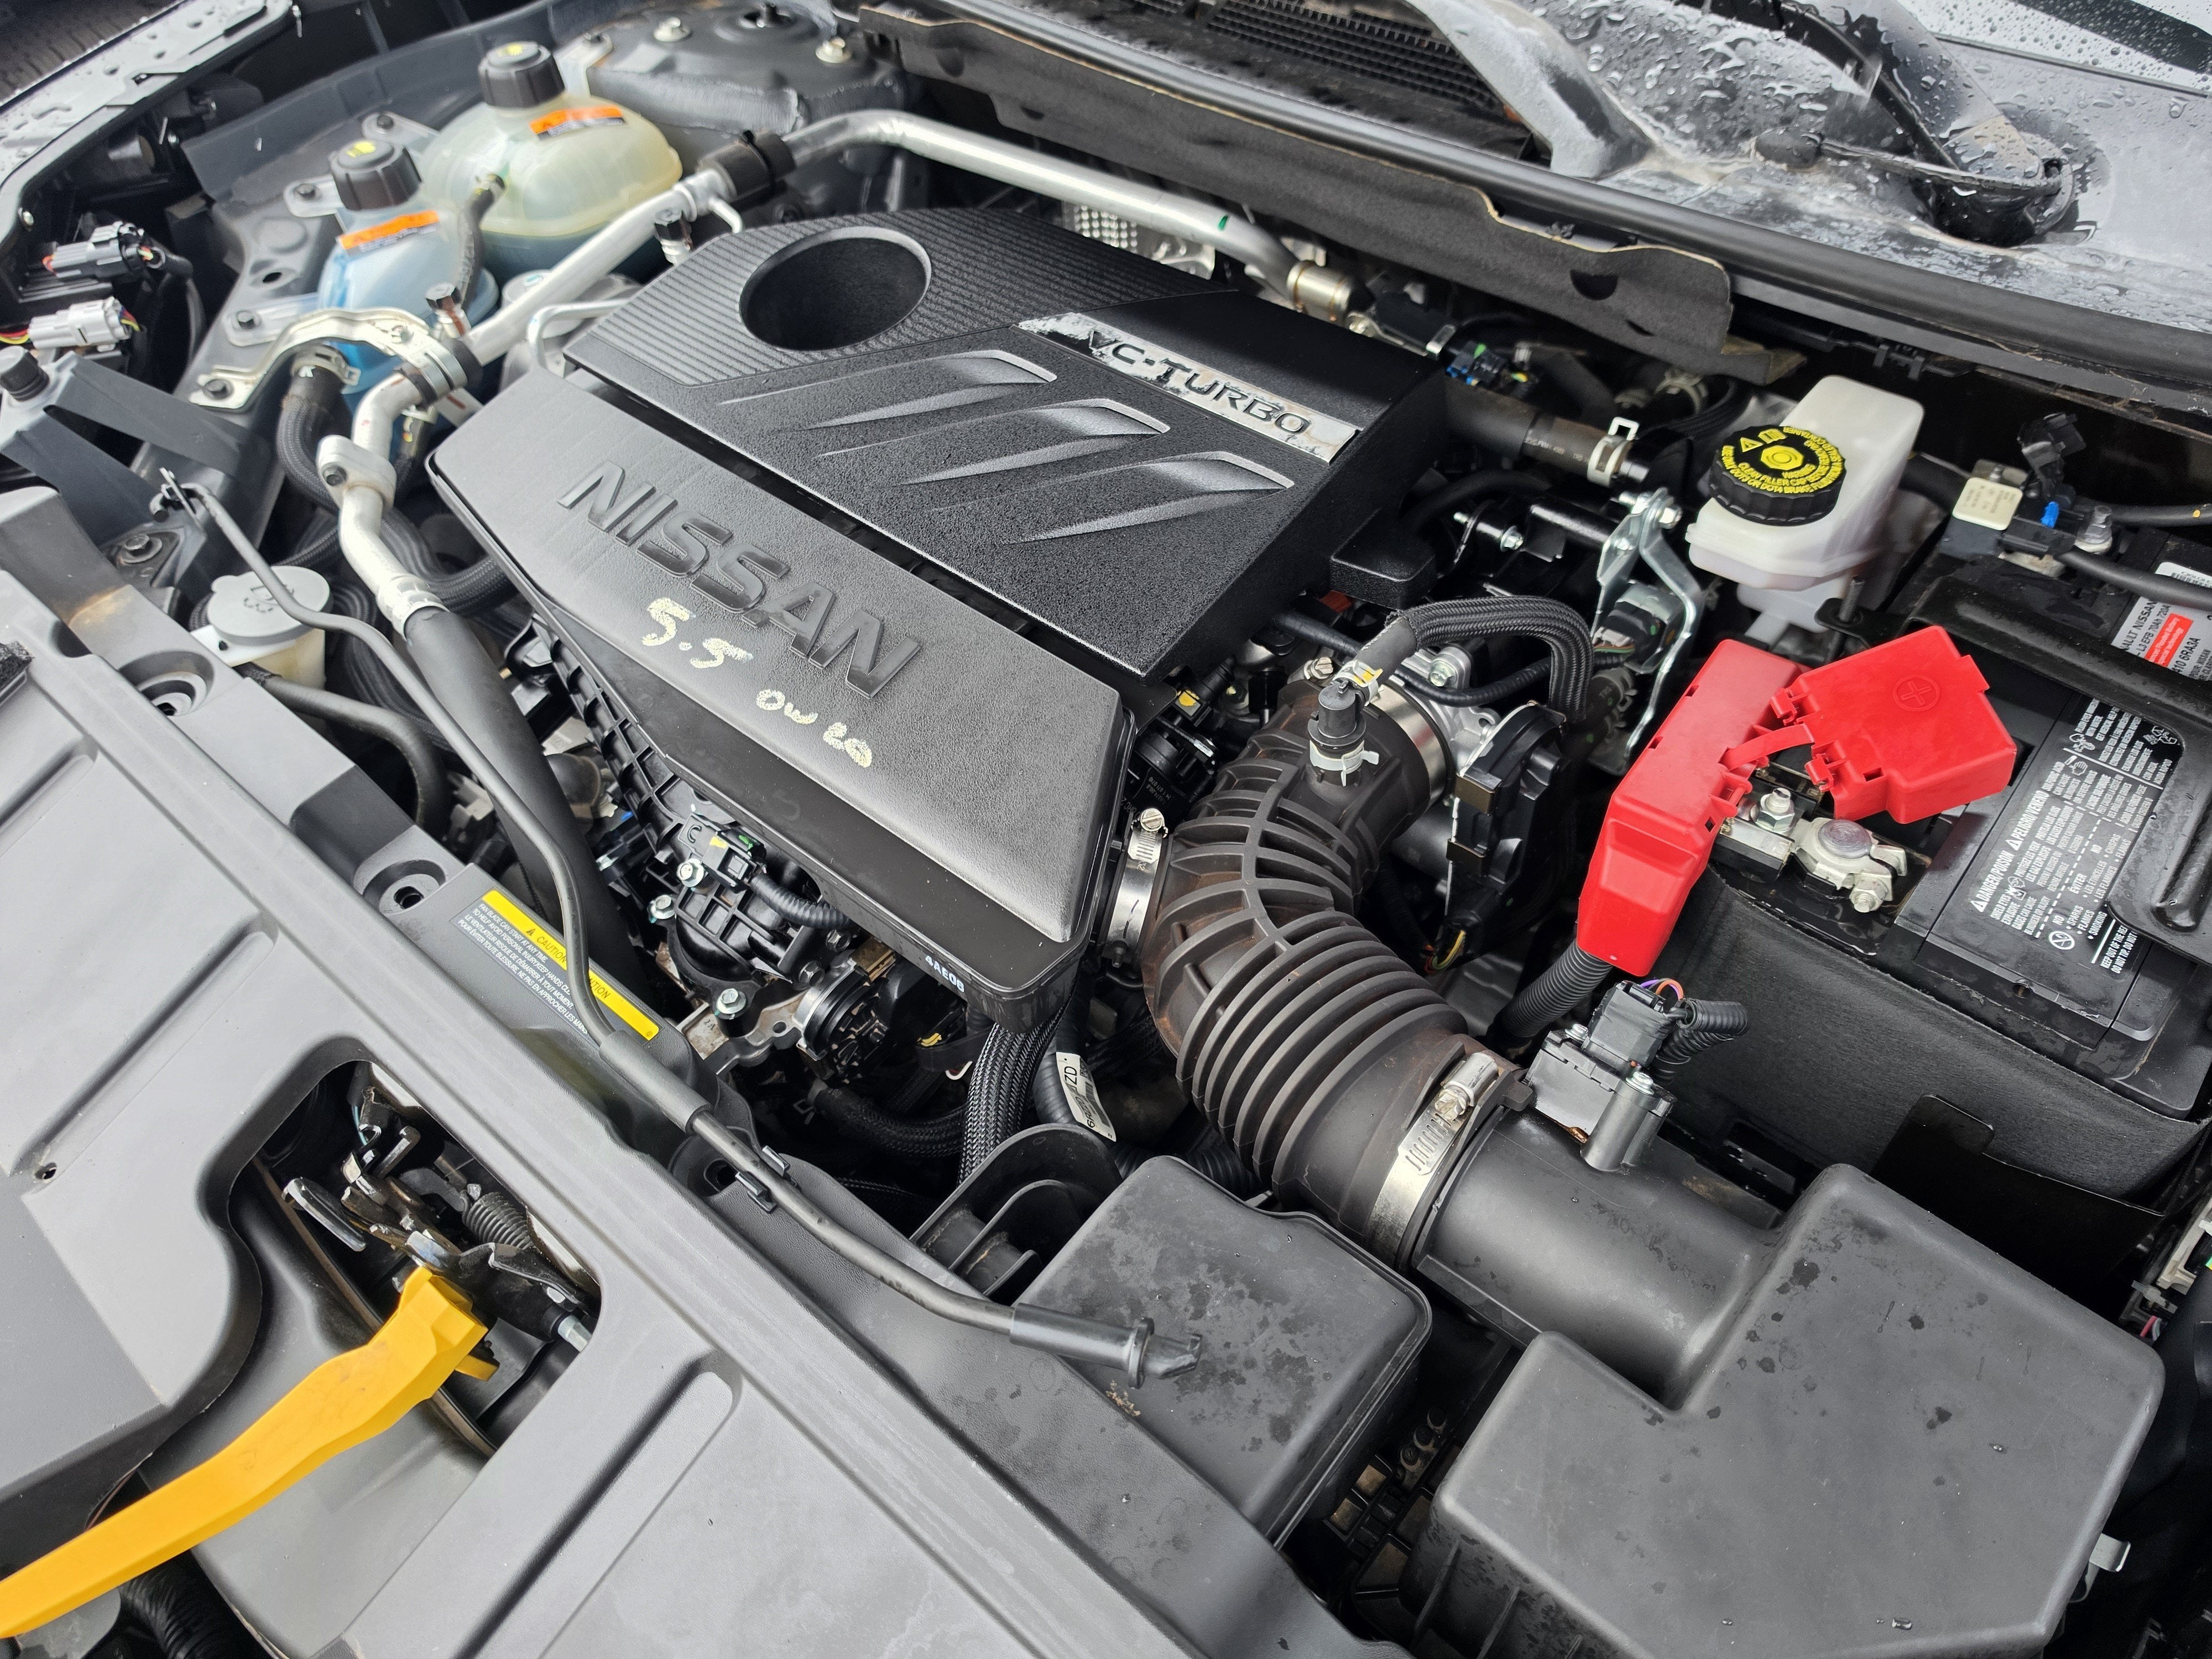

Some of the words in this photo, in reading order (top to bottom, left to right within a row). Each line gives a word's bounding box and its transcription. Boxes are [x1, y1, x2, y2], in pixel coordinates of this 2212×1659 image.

[1089, 331, 1311, 435] VC-TURBO
[1738, 462, 1761, 479] CLEAN
[1760, 474, 1790, 486] FILLER
[1790, 476, 1807, 486] CAP
[1782, 463, 1816, 478] WARNING
[1760, 483, 1783, 493] DOT4
[557, 462, 922, 698] NISSAN
[2132, 599, 2157, 629] NISSAN
[642, 597, 753, 669] 5.5
[2178, 636, 2201, 660] 6RA3A
[2011, 790, 2049, 841] PELIGRO/VENENO
[2090, 844, 2103, 853] NO
[2104, 833, 2122, 853] CHISPAS
[2115, 838, 2132, 858] FLAMAS
[1976, 850, 2014, 901] DANGER/POISON
[2067, 872, 2087, 893] ÉVITER
[2098, 865, 2118, 889] FLAMMES
[2083, 884, 2095, 894] LES
[2094, 888, 2106, 899] LES
[1997, 894, 2011, 906] EYES
[2023, 896, 2037, 909] CAUSE
[1990, 904, 2006, 920] SHIELD
[2001, 902, 2020, 925] EXPLOSIVE
[2019, 907, 2031, 917] CAN
[2052, 915, 2065, 925] NO
[2066, 905, 2084, 925] SPARKS
[2077, 910, 2095, 930] FLAMES
[2011, 915, 2027, 930] GASES
[2023, 914, 2042, 935] BLINDNESS
[2088, 911, 2109, 935] SMOKING
[478, 903, 489, 913] FAN
[486, 909, 502, 924] BLADE
[499, 921, 512, 932] CAN
[508, 928, 523, 942] START
[520, 938, 529, 947] AT
[525, 943, 539, 954] ANY
[535, 951, 548, 963] TIME.
[2112, 933, 2125, 943] THE
[2125, 933, 2137, 943] NOT
[477, 913, 491, 925] HELP
[488, 922, 503, 936] AVOID
[499, 932, 524, 953] PERSONAL
[545, 971, 564, 987] HANDS
[535, 935, 568, 964] CAUTION
[2105, 947, 2117, 957] OUT
[2118, 948, 2130, 957] TIP.
[457, 919, 472, 932] POUR
[469, 927, 487, 943] ÉVITER
[482, 940, 499, 955] TOUTE
[494, 951, 520, 973] BLESSURE,
[517, 969, 526, 979] NE
[523, 975, 535, 986] PAS
[531, 983, 541, 992] EN
[538, 988, 567, 1014] APPROCHER
[564, 1011, 576, 1022] LES
[469, 918, 497, 942] VENTILATEUR
[494, 939, 513, 956] RISQUE
[509, 952, 518, 961] DE
[516, 957, 541, 980] DÉMARRER
[541, 980, 556, 993] TOUT
[552, 989, 575, 1009] MOMENT.
[2099, 956, 2113, 968] KEEP
[2114, 956, 2126, 966] NOT
[925, 954, 966, 993] 4AE06
